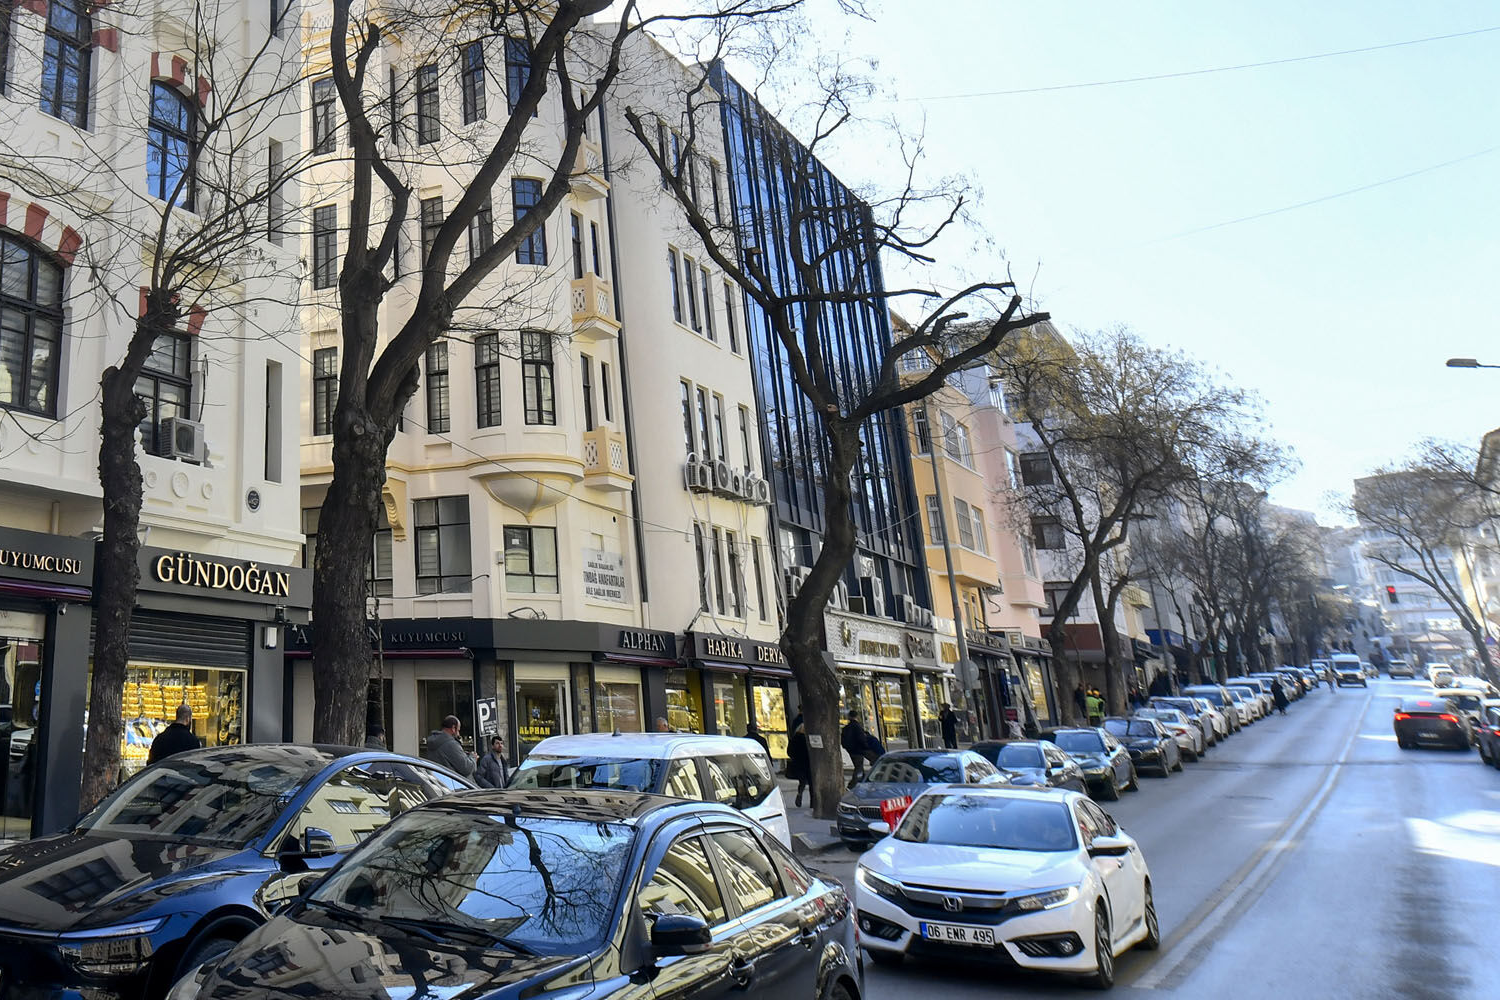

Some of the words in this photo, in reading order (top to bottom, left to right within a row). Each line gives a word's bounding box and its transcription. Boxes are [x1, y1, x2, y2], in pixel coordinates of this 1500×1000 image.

[157, 552, 290, 597] GÜNDOĞAN
[391, 632, 466, 643] KUYUMCUSU
[622, 631, 666, 651] ALPHAN
[707, 638, 743, 658] HARİKA
[757, 645, 784, 664] DERYA
[479, 703, 490, 734] P
[519, 726, 550, 735] ALPHAN
[928, 924, 940, 938] 06
[946, 927, 966, 941] ENR
[973, 930, 992, 943] 495
